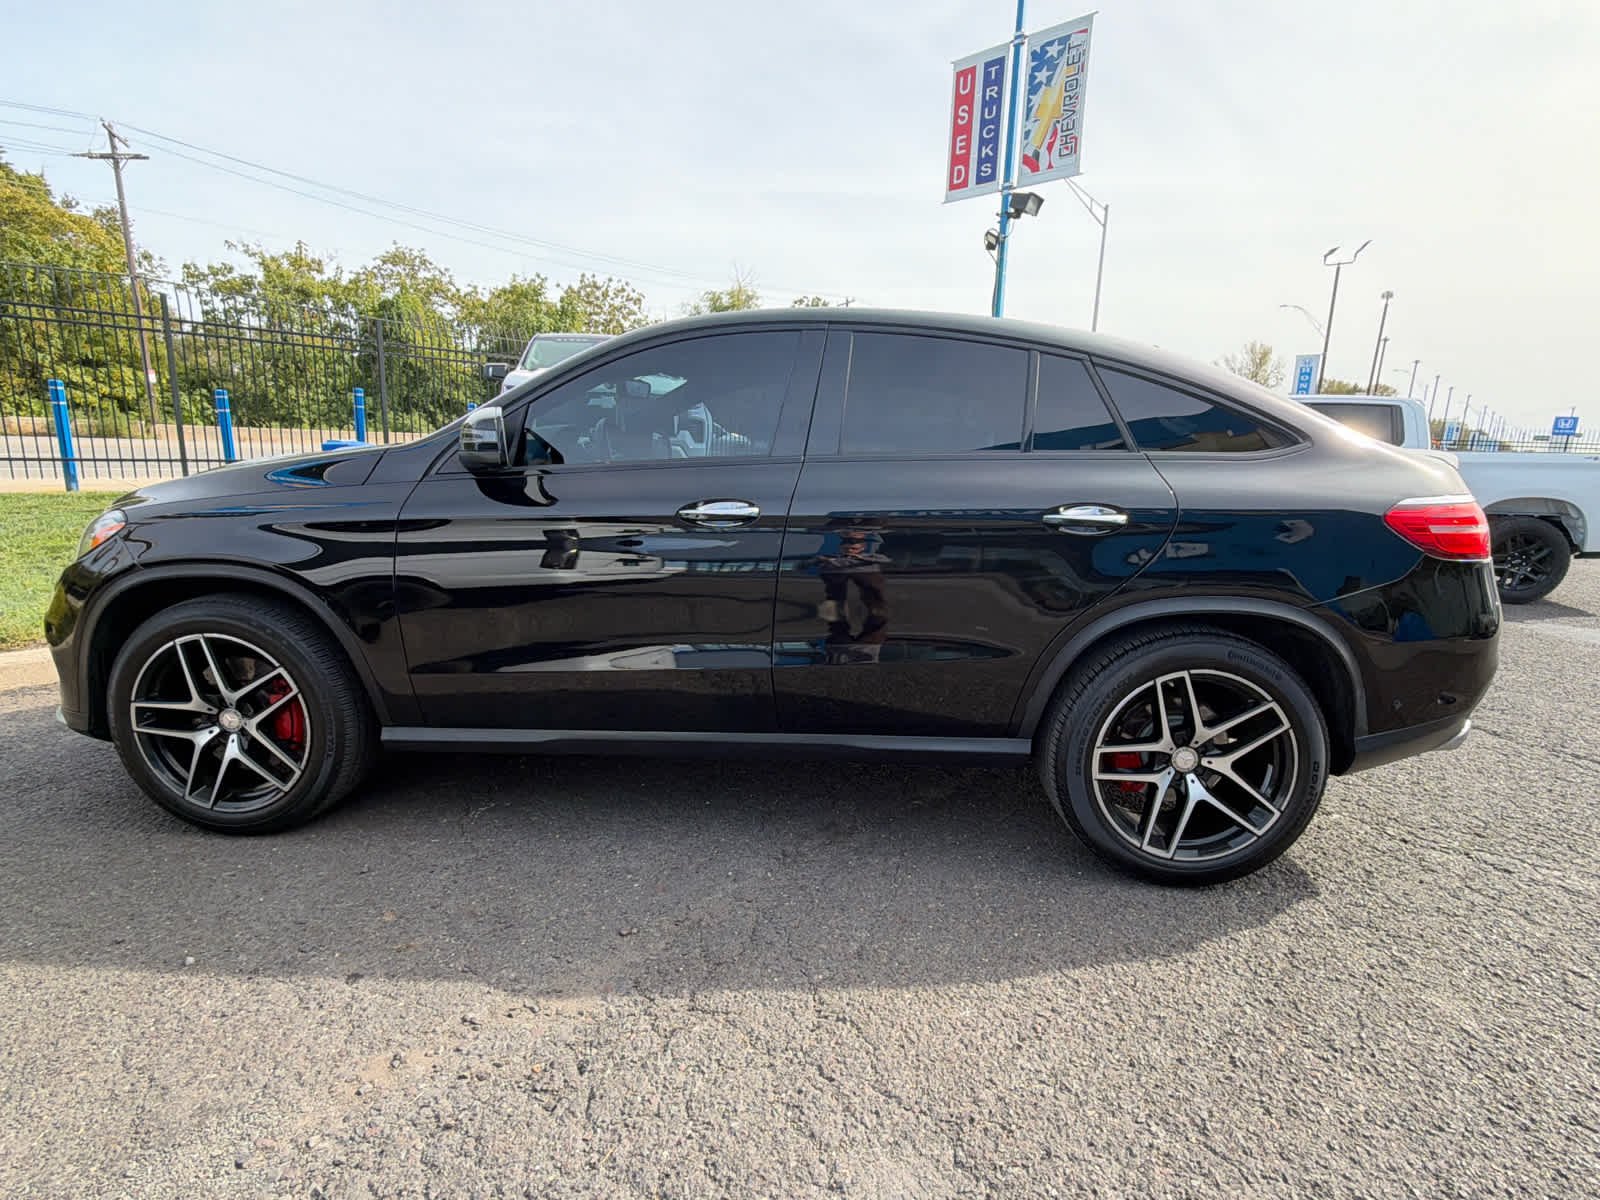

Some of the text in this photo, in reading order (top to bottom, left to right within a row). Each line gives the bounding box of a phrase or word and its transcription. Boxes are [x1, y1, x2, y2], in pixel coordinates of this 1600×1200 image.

[953, 74, 972, 184] USED
[980, 65, 1000, 177] TRUCKS
[1058, 41, 1083, 158] CHEVROLET
